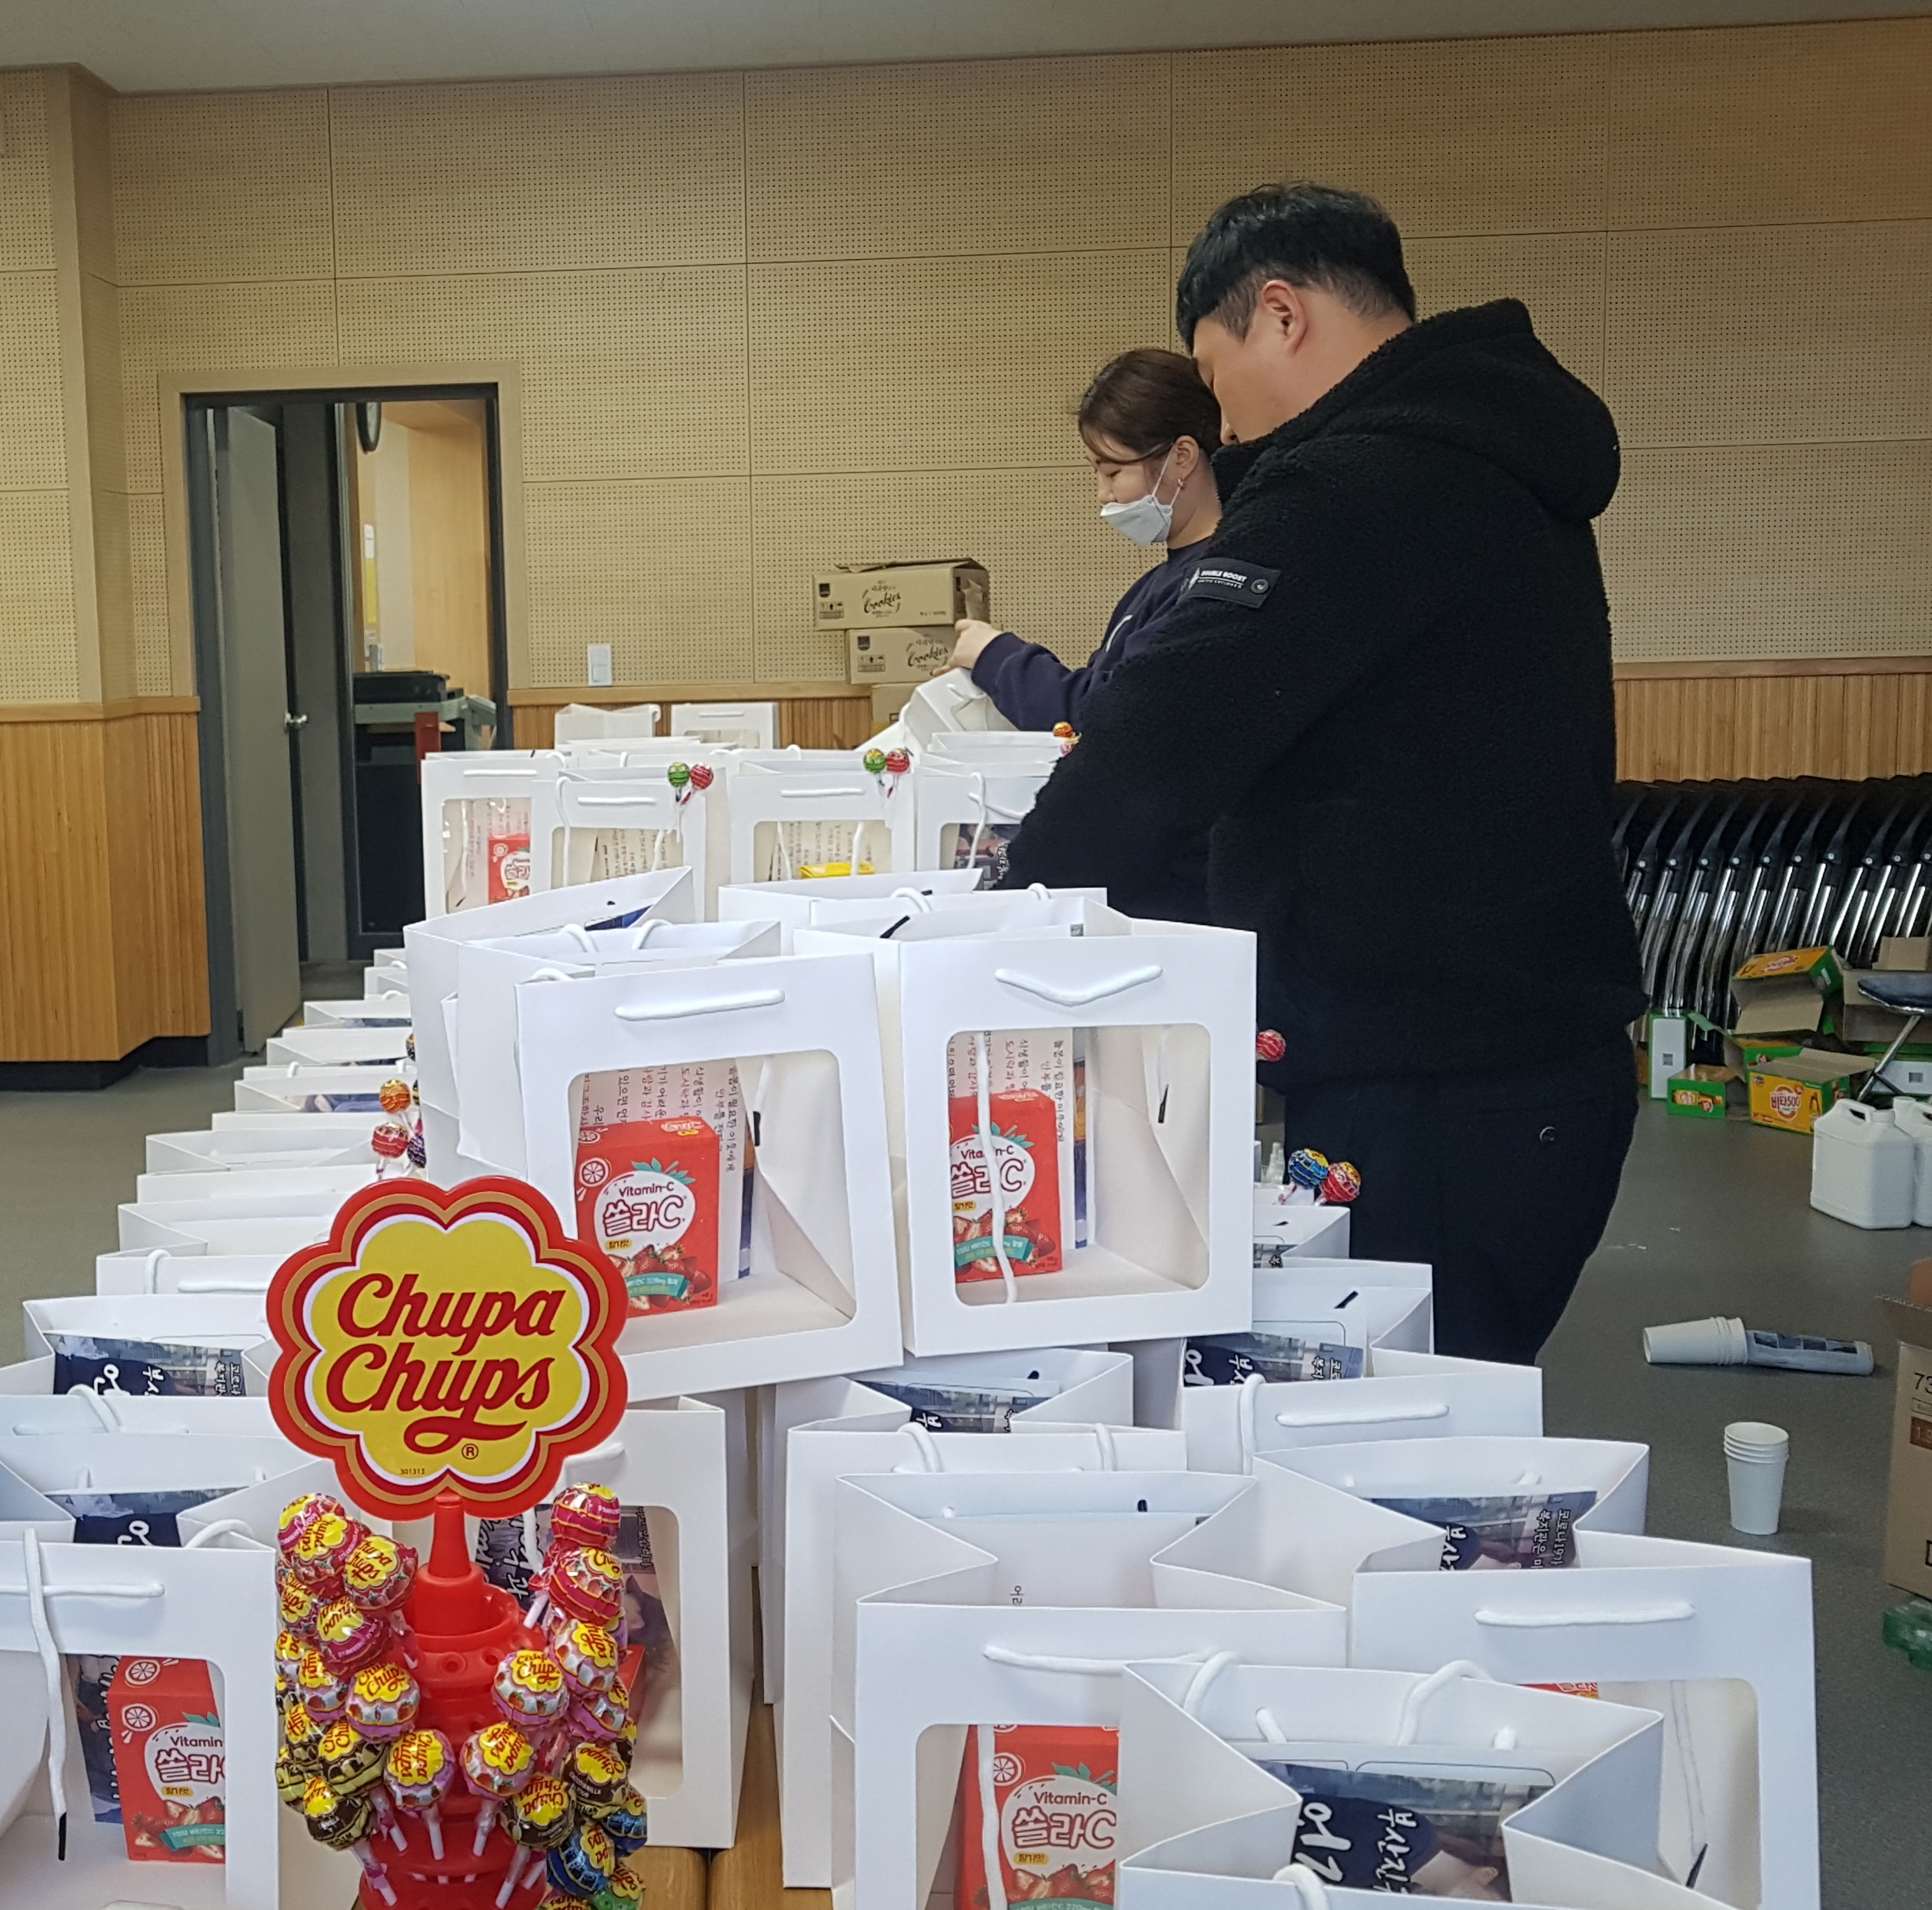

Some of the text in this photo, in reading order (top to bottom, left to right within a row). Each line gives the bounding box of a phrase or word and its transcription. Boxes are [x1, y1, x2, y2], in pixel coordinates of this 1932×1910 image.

[619, 1181, 675, 1197] Vitamin-C
[337, 1273, 566, 1357] Chupa
[325, 1342, 556, 1454] Chups
[399, 1467, 426, 1476] 301313
[1530, 1510, 1553, 1554] 복지관은
[1550, 1508, 1570, 1566] 코로나19가
[392, 1732, 416, 1778] Chups
[418, 1733, 432, 1779] Chupa
[522, 1791, 565, 1815] Chupa
[1033, 1791, 1107, 1805] Vitamin-C
[1012, 1805, 1117, 1849] 쏠라C
